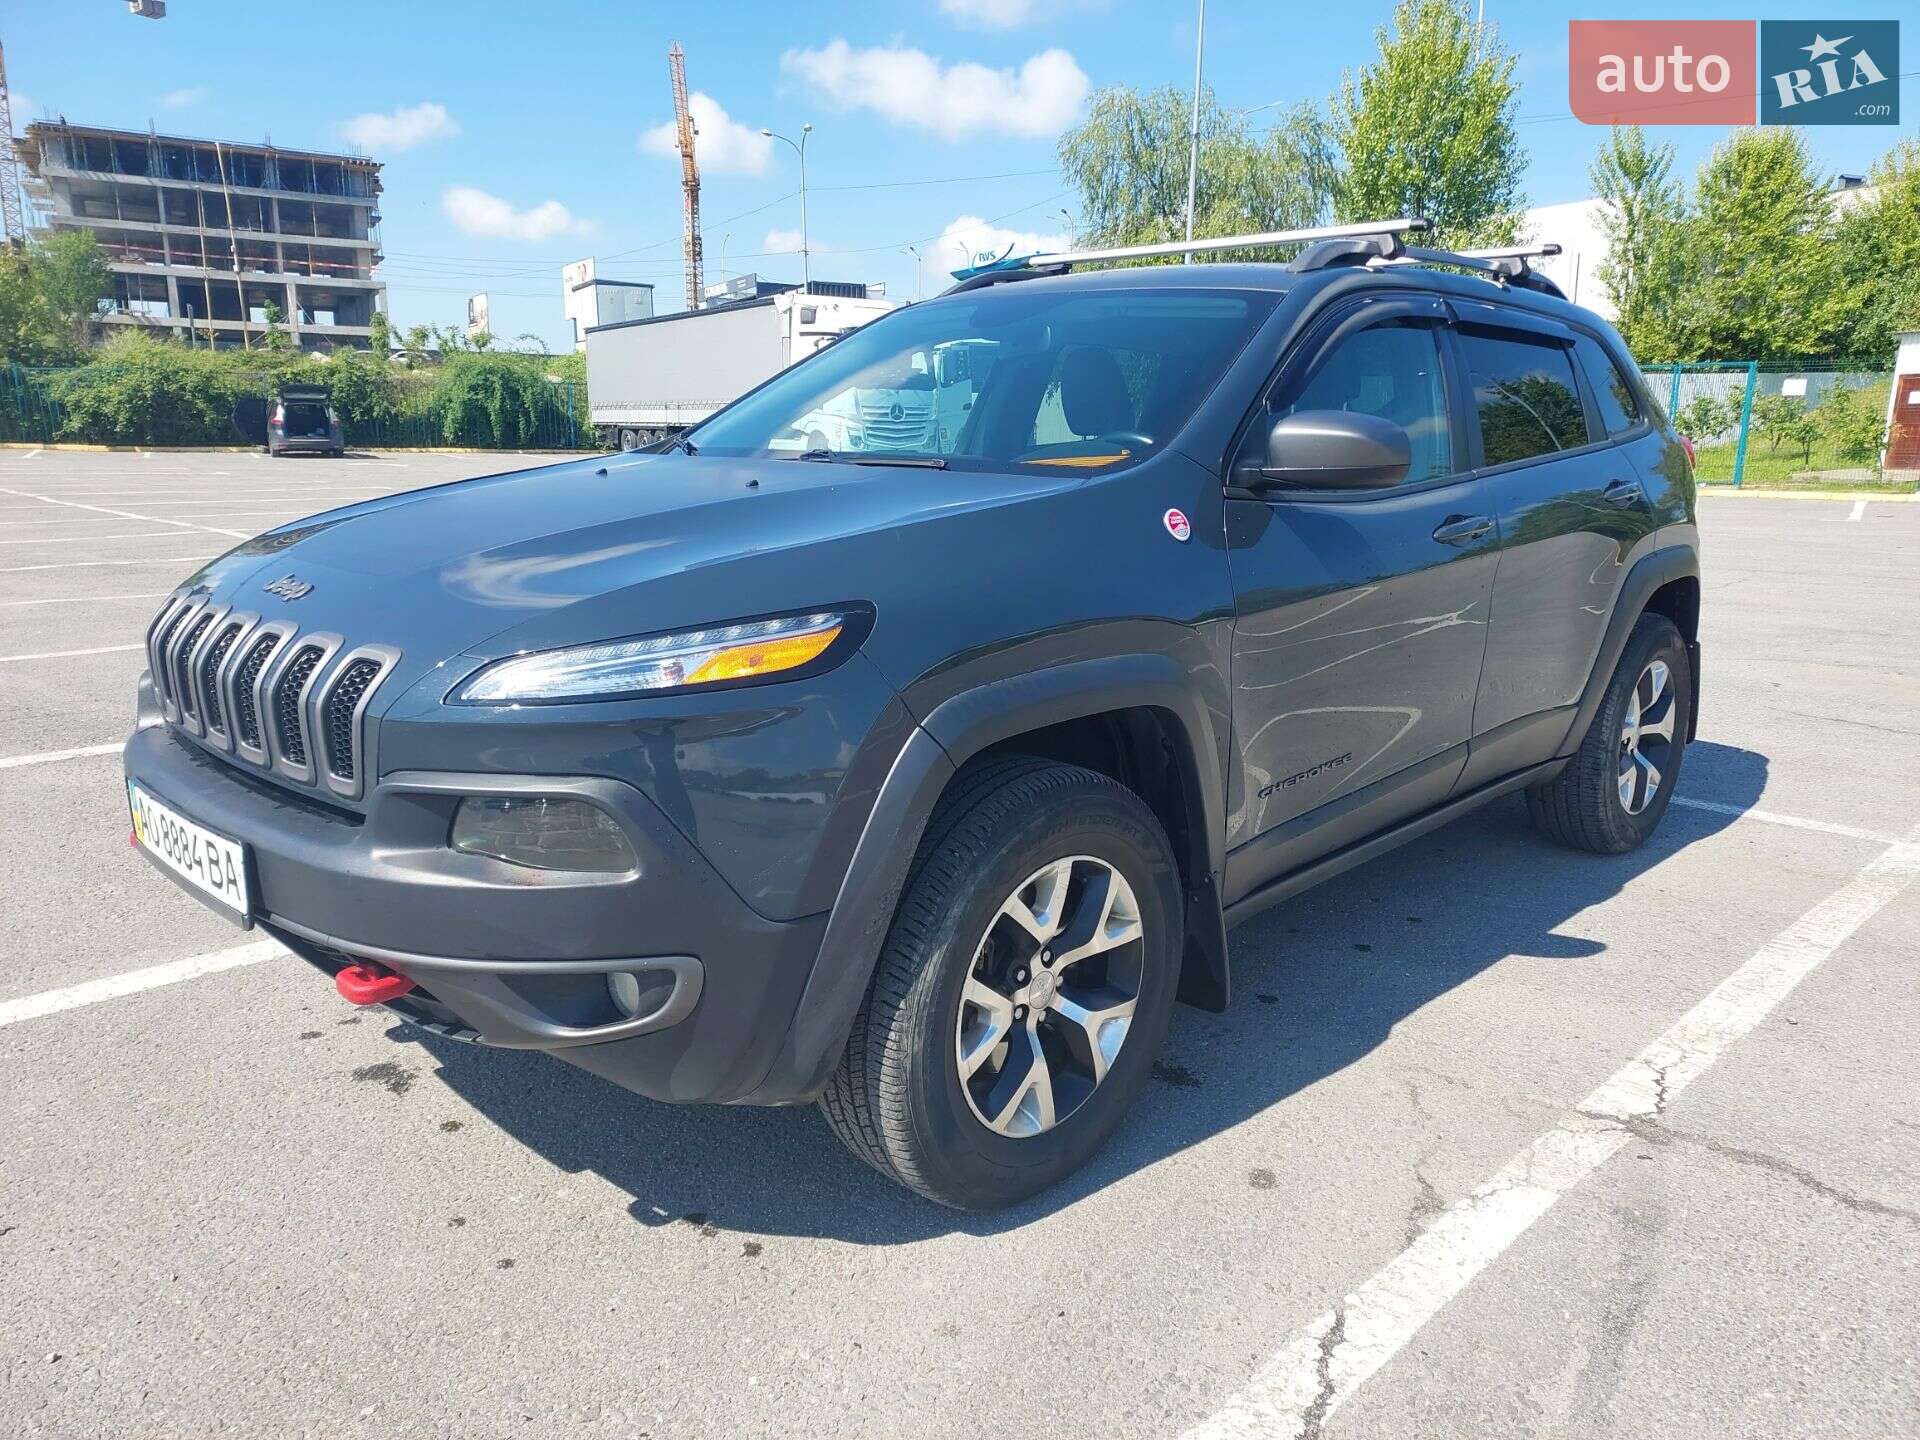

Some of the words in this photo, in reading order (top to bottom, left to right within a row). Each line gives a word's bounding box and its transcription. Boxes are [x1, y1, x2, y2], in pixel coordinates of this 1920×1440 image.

[262, 573, 315, 602] Jeep
[1257, 752, 1353, 800] CHEROKEE
[160, 814, 205, 880] 8884
[205, 839, 242, 901] BA
